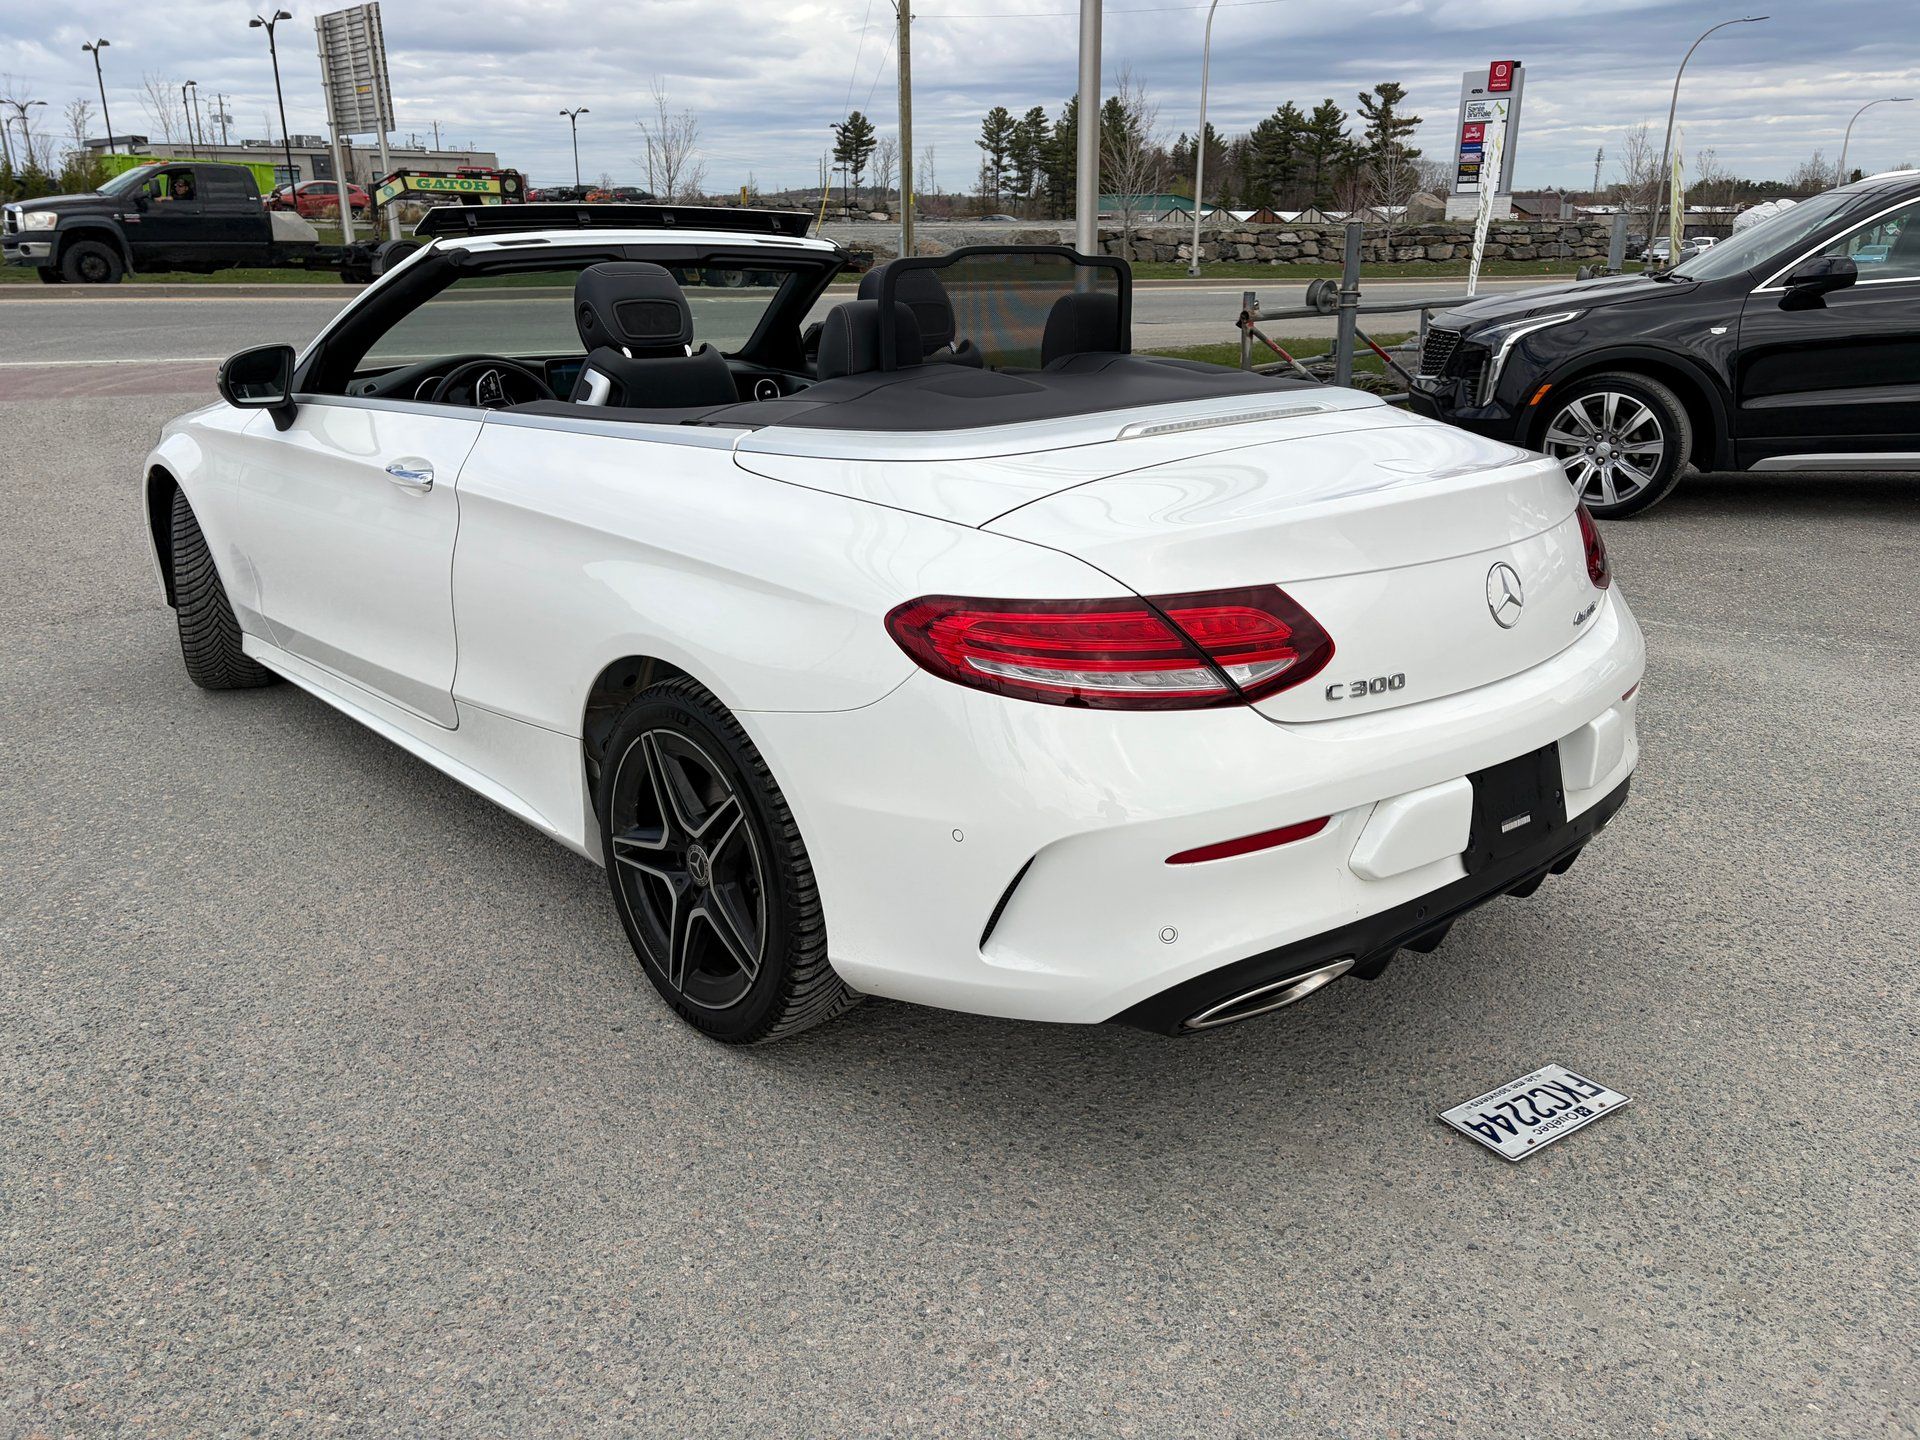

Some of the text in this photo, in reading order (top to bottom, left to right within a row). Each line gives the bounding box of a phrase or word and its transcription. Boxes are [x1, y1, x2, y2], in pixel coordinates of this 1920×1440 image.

[415, 178, 490, 191] GATOR
[1326, 672, 1406, 701] C 300
[1510, 1080, 1526, 1089] me
[1462, 1073, 1606, 1144] FKC2244
[1531, 1112, 1580, 1136] Québec
